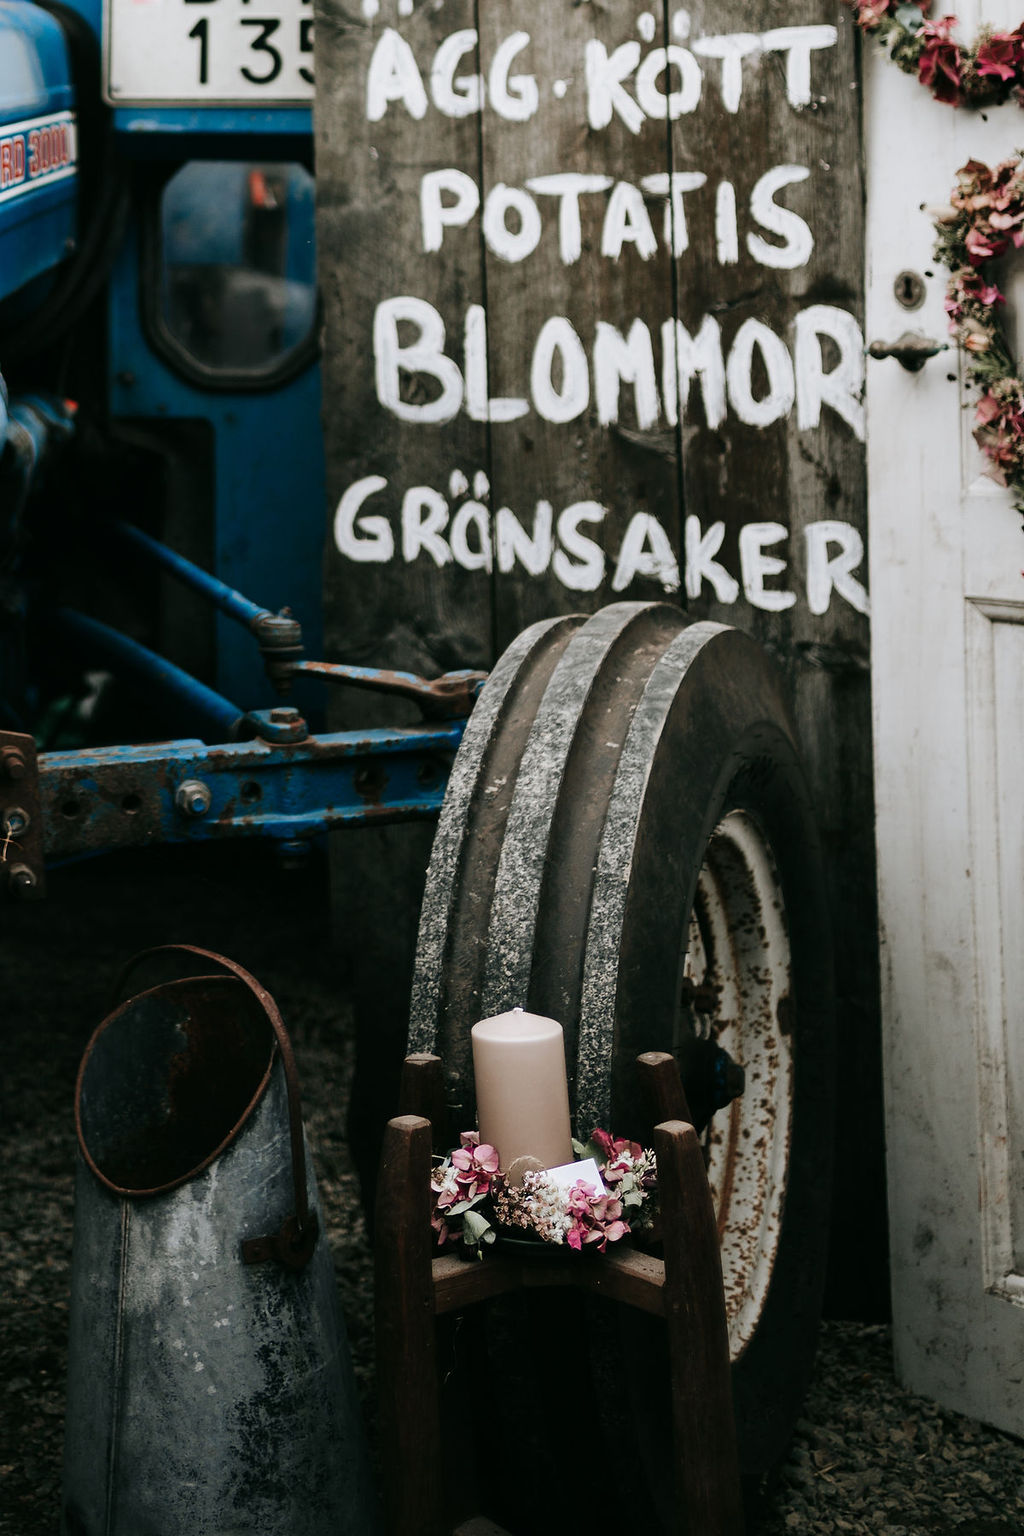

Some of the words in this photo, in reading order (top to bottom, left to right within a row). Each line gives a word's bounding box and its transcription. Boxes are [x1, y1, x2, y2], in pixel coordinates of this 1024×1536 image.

[584, 10, 839, 135] KÖTT
[420, 165, 815, 270] POTATIS
[372, 296, 868, 444] BLOMMOR
